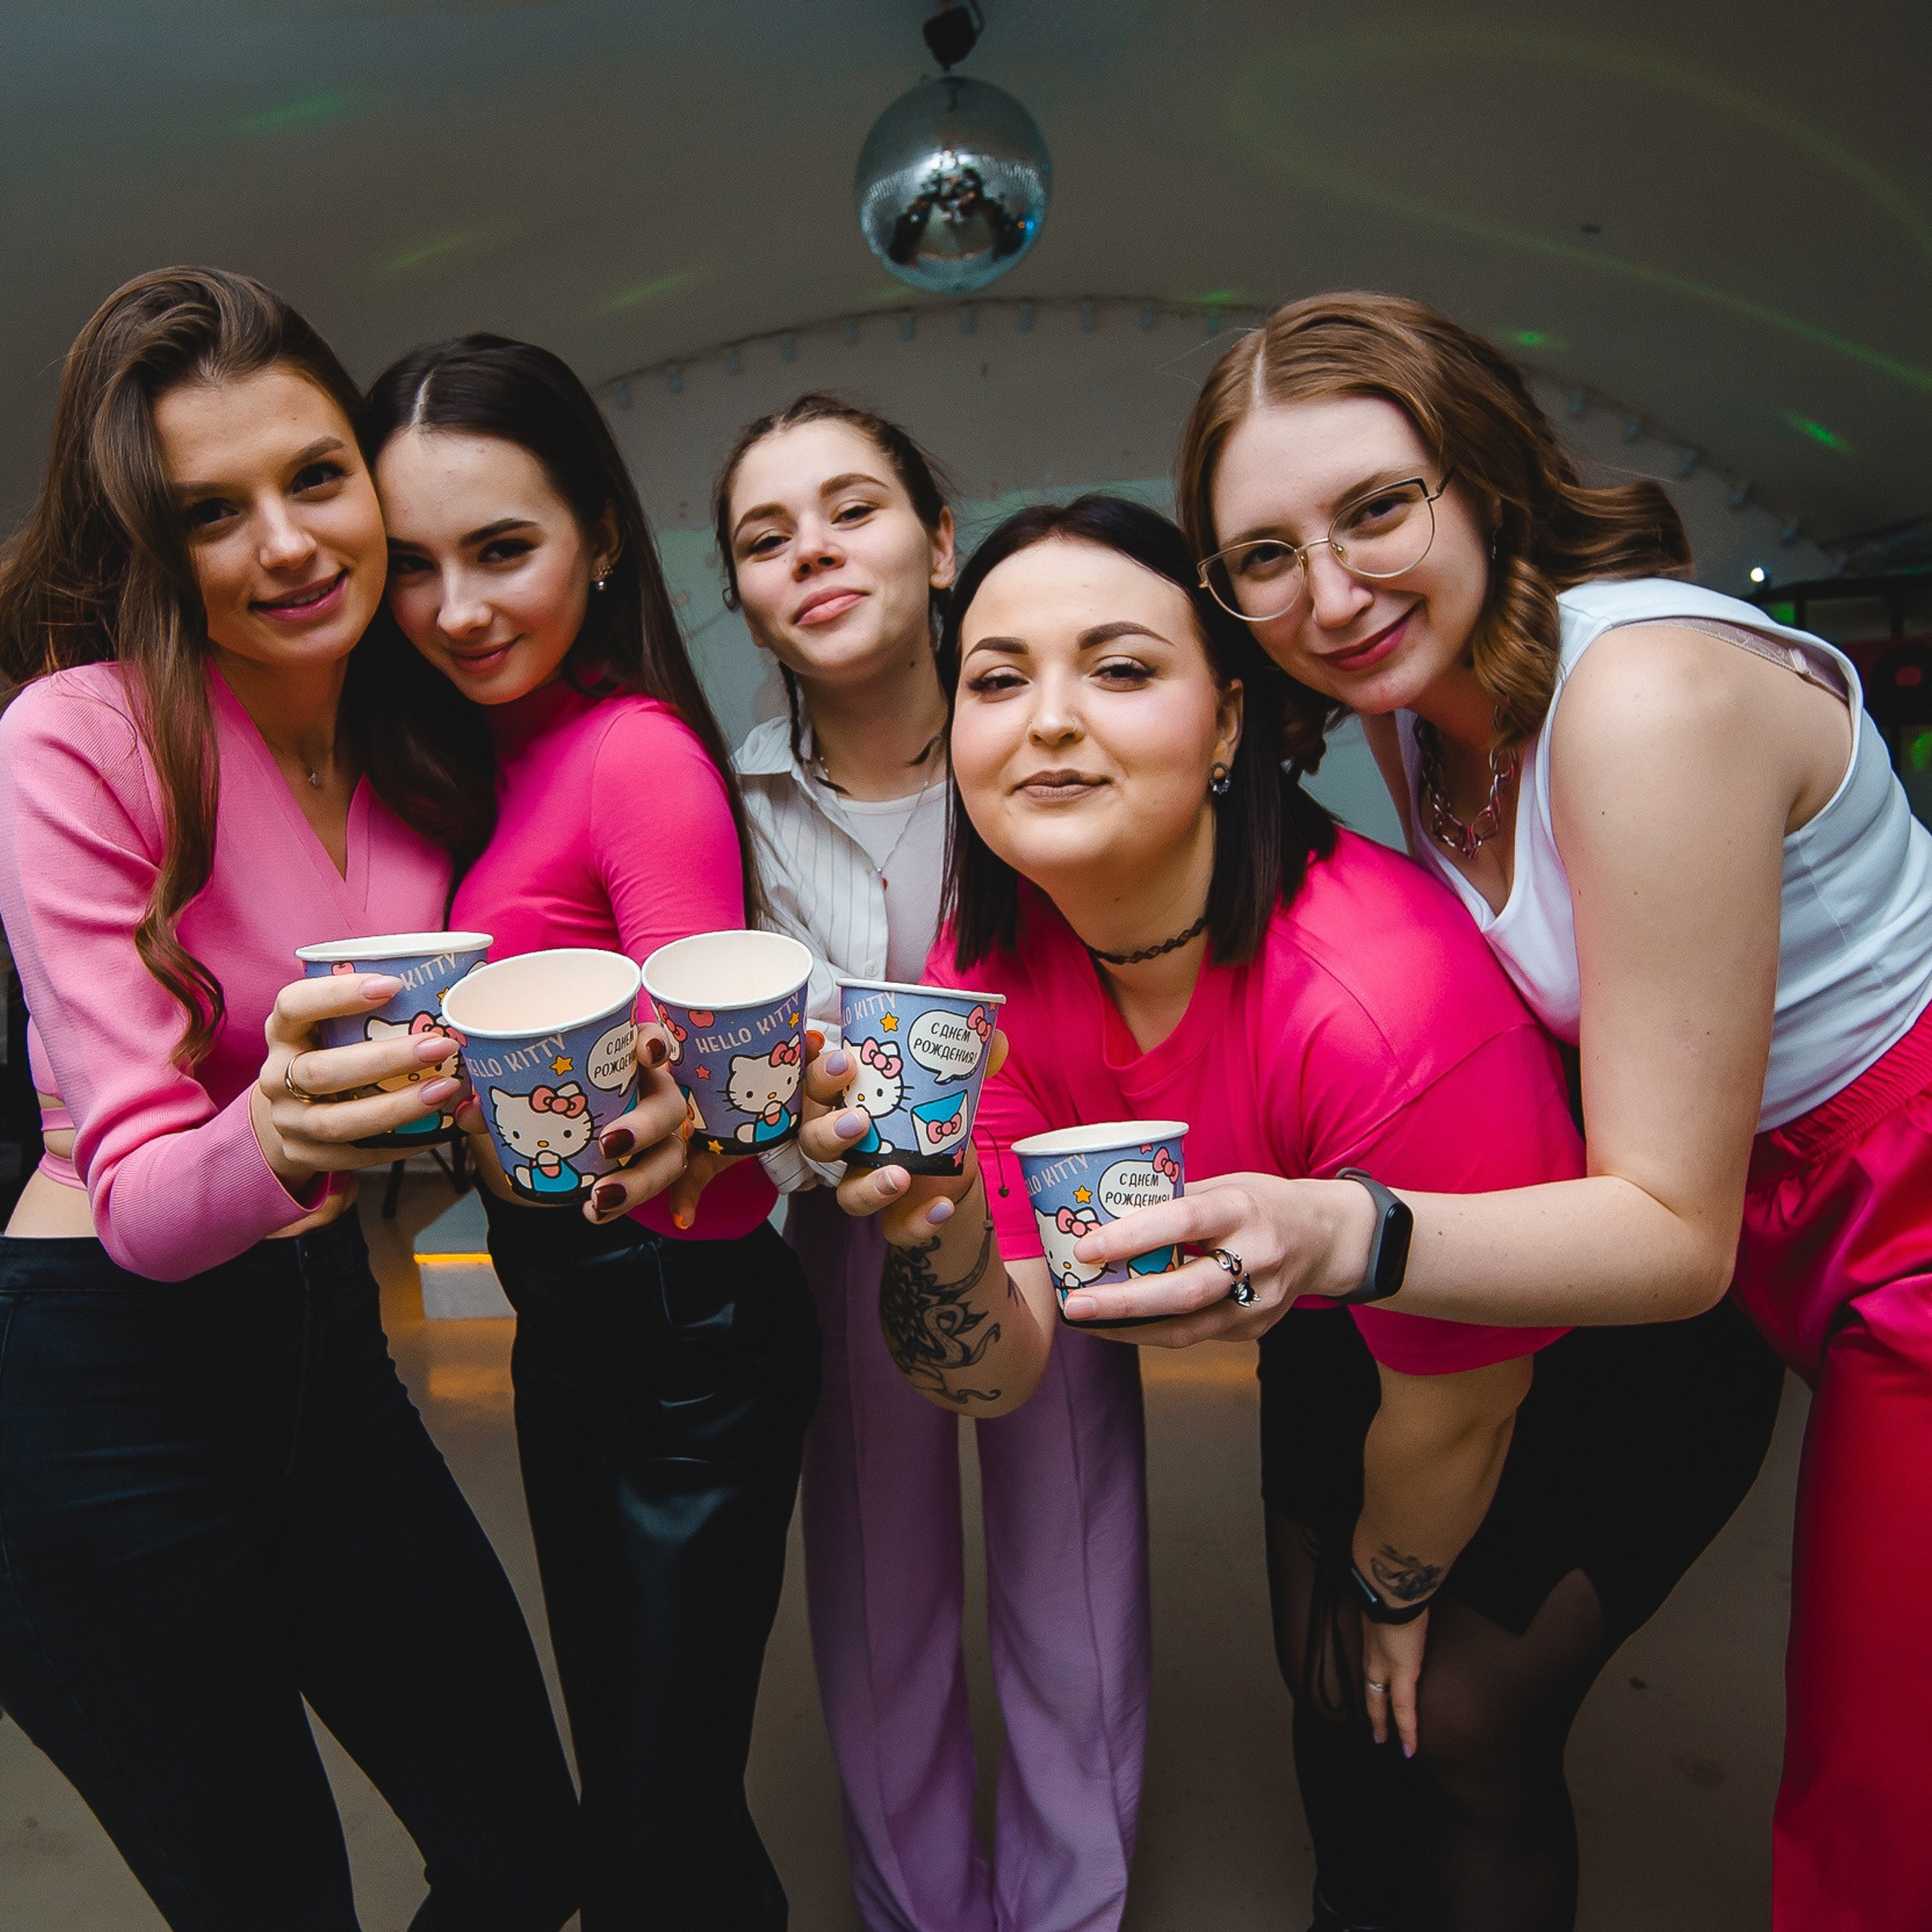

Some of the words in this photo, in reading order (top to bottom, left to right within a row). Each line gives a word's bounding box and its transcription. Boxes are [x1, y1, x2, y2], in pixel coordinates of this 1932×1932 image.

[399, 952, 456, 991] KITTY
[854, 991, 896, 1020] KITTY
[695, 1027, 752, 1054] HELLO
[756, 992, 798, 1035] KITTY
[939, 1024, 971, 1043] ДНЕМ
[503, 1033, 566, 1072] KITTY
[913, 1038, 978, 1065] РОЖДЕНИЯ!
[1041, 1154, 1088, 1188] KITTY
[1128, 1173, 1159, 1187] ДНЕМ
